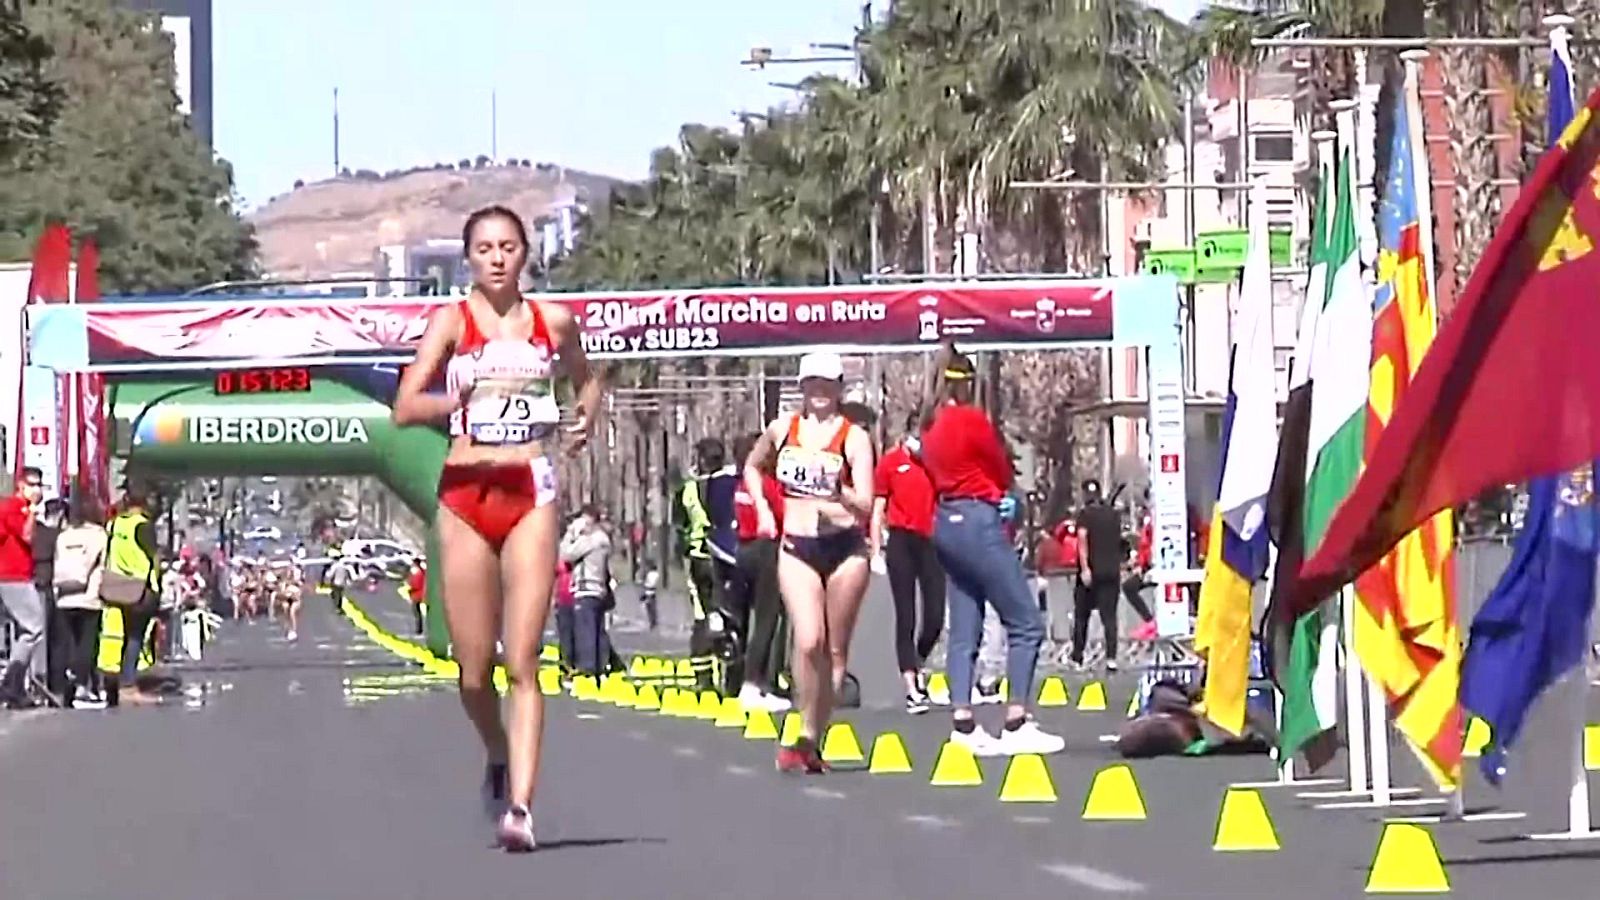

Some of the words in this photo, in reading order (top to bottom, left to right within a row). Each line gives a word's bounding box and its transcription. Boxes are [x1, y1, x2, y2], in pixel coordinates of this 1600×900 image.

[585, 301, 667, 327] 20km
[675, 297, 788, 325] Marcha
[795, 303, 826, 323] en
[832, 299, 887, 322] Ruta
[579, 332, 626, 351] luto
[645, 328, 720, 350] SUB23
[498, 395, 531, 420] 79
[190, 416, 369, 443] IBERDROLA
